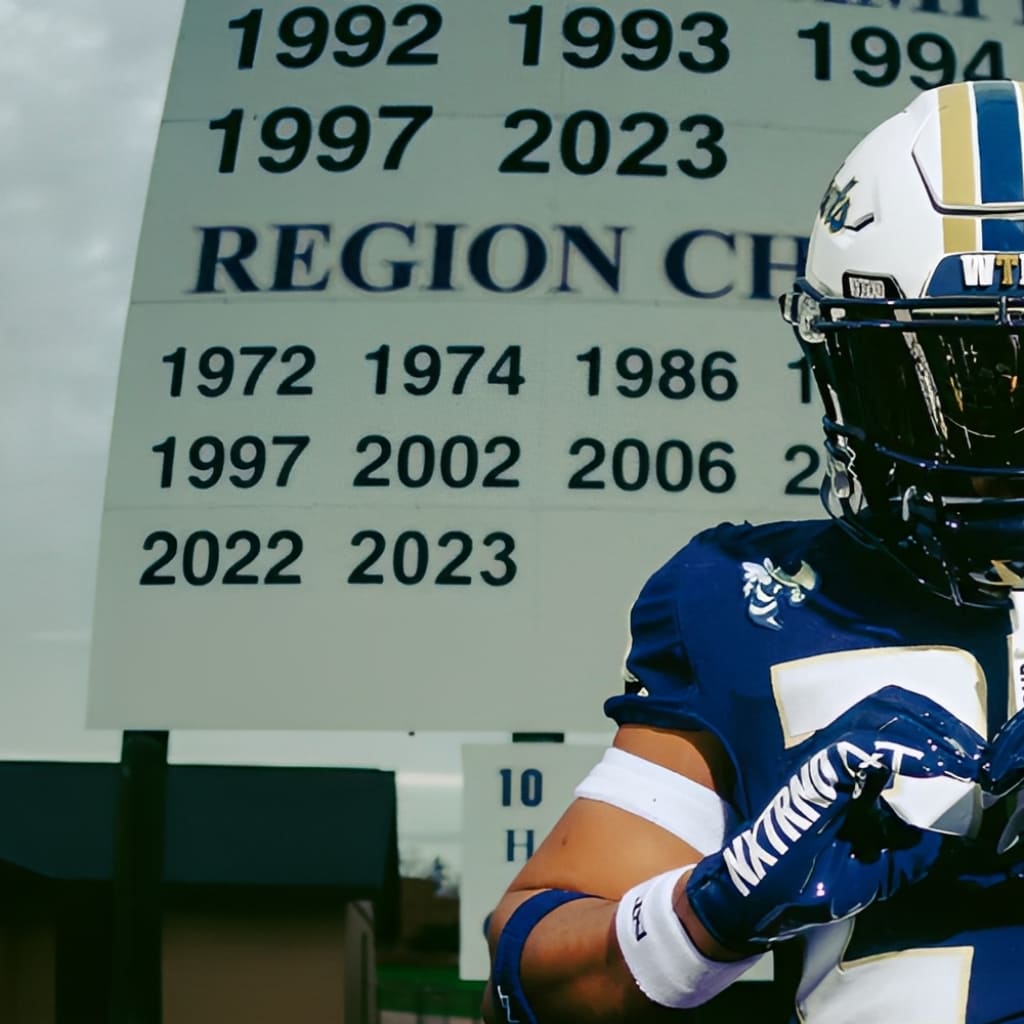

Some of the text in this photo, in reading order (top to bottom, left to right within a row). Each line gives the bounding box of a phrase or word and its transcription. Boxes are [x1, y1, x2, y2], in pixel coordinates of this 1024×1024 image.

[227, 3, 443, 70] 1992
[508, 4, 731, 74] 1993
[797, 20, 1010, 90] 1994
[208, 104, 728, 180] 1997 2023
[186, 221, 630, 296] REGION
[161, 344, 317, 399] 1972
[364, 343, 527, 397] 1974
[576, 346, 740, 402] 1986
[151, 435, 311, 490] 1997
[352, 434, 522, 489] 2002
[567, 437, 738, 494] 2006
[139, 529, 518, 587] 2022 2023
[499, 768, 543, 808] 10
[722, 748, 839, 897] NXTRND
